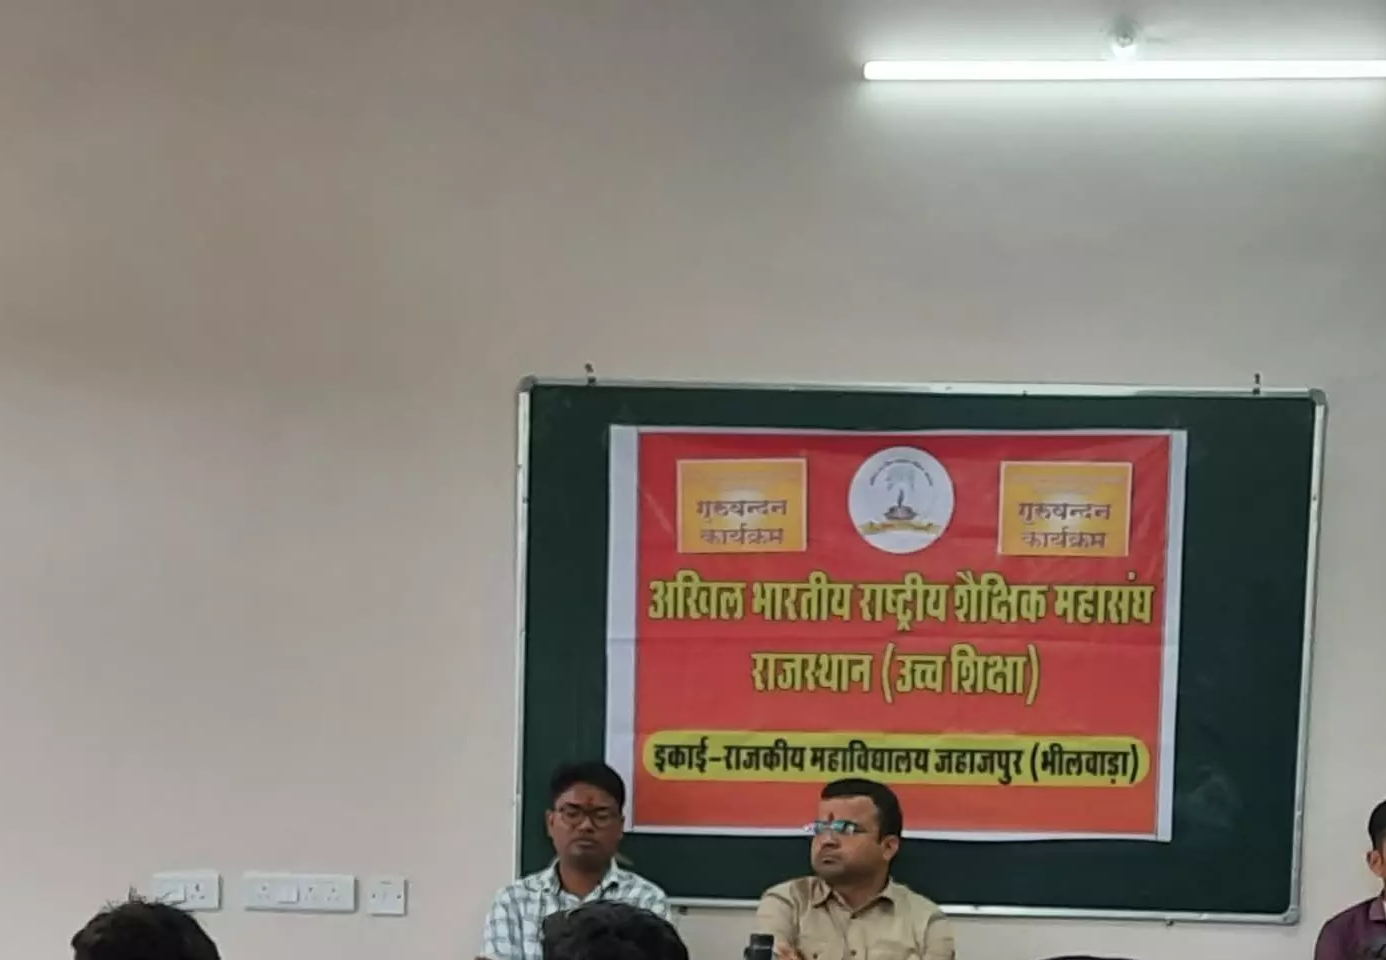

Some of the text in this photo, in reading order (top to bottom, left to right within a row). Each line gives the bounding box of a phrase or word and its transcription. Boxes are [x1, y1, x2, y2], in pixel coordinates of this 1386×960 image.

[700, 523, 784, 545] कार्यक्रम
[1021, 526, 1106, 548] कार्यक्रम
[647, 569, 1155, 632] अखिल भारतीय राष्ट्रीय शैक्षिक महासंघ
[750, 641, 1040, 705] राजस्थान (उच्च शिक्षा)
[810, 739, 930, 773] महाविद्यालय
[934, 748, 1025, 785] जहाजपुर
[1029, 742, 1139, 784] (भीलवाड़ा)
